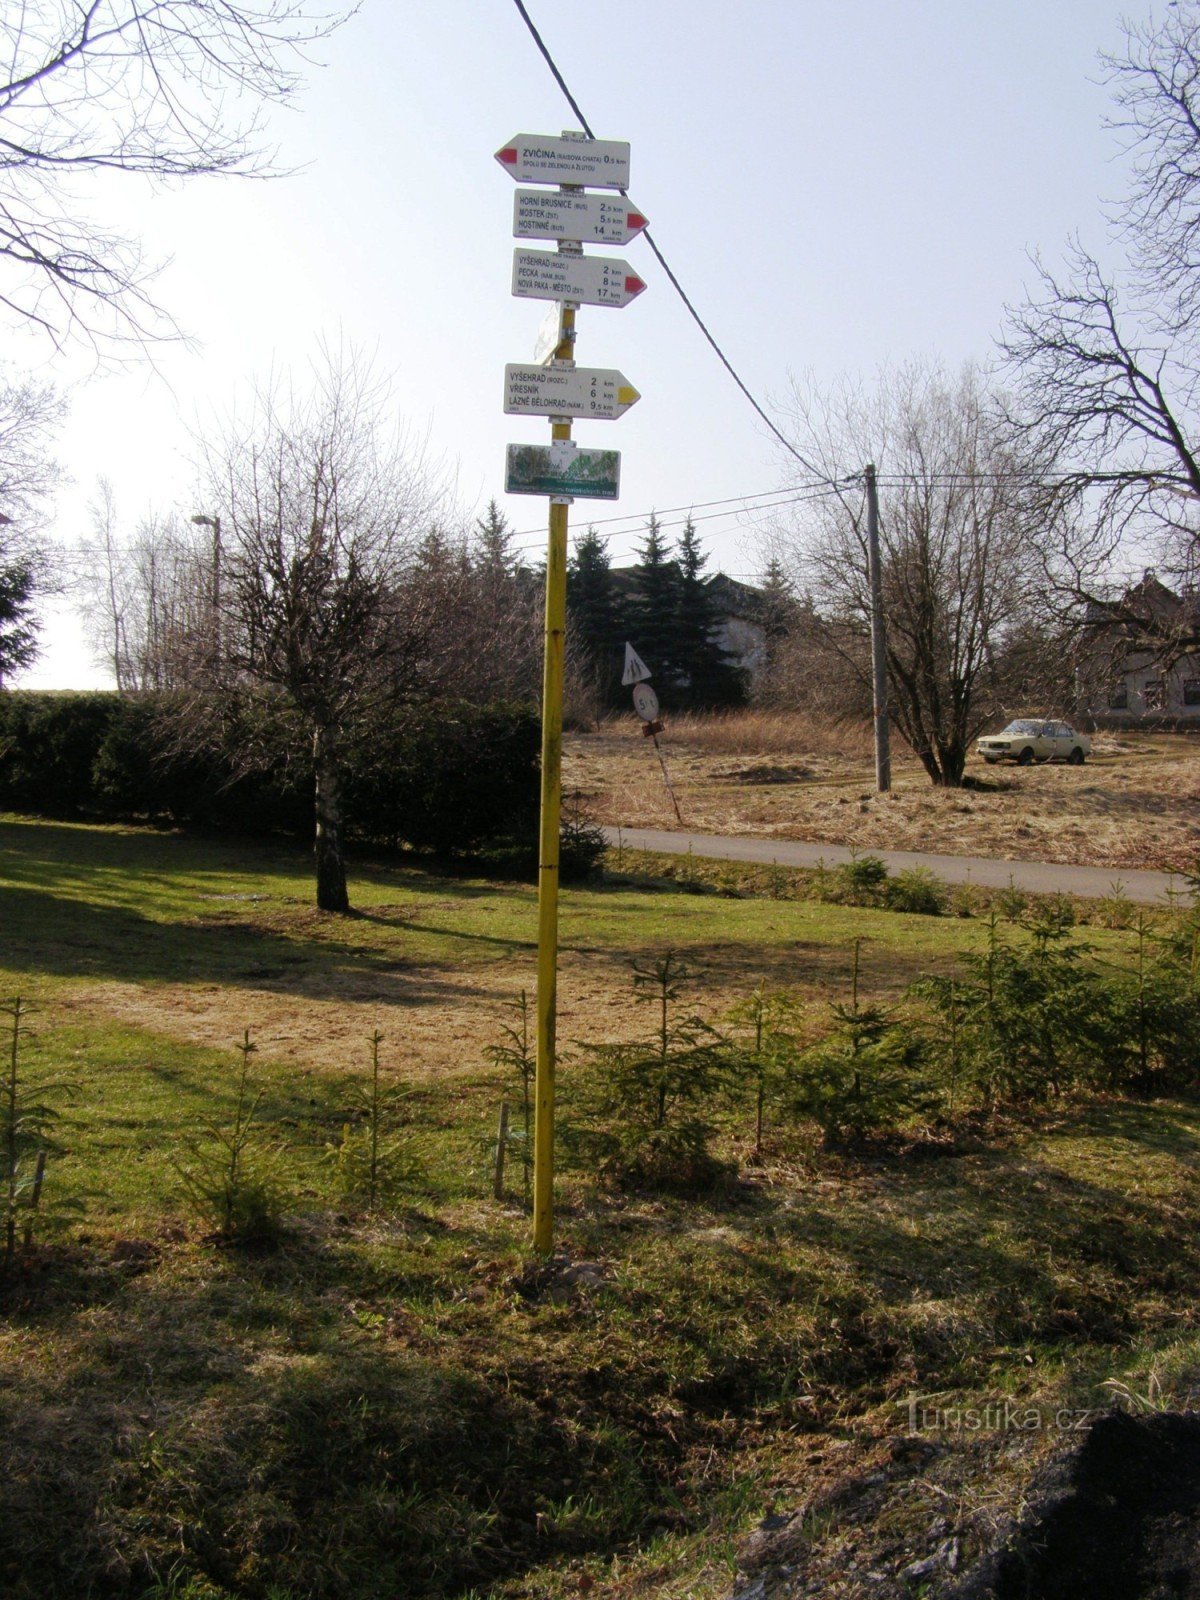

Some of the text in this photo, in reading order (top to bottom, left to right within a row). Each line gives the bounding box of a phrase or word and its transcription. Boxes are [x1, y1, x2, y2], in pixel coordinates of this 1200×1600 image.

[520, 197, 540, 205] HORNÍ
[541, 199, 572, 208] BRUSNICE
[519, 209, 544, 218] MOSTEK
[519, 220, 549, 230] HOSTINNÉ
[594, 226, 604, 234] 14
[519, 256, 550, 267] VYŠEHRAD
[519, 268, 538, 277] PECKA
[534, 281, 548, 289] PAKA
[510, 371, 546, 382] VYŠEHRAD
[591, 377, 596, 386] 2
[509, 383, 539, 394] VŘESNÍK
[590, 389, 596, 398] 6
[532, 397, 566, 408] BĚLOHRAD
[590, 401, 602, 411] 9,5
